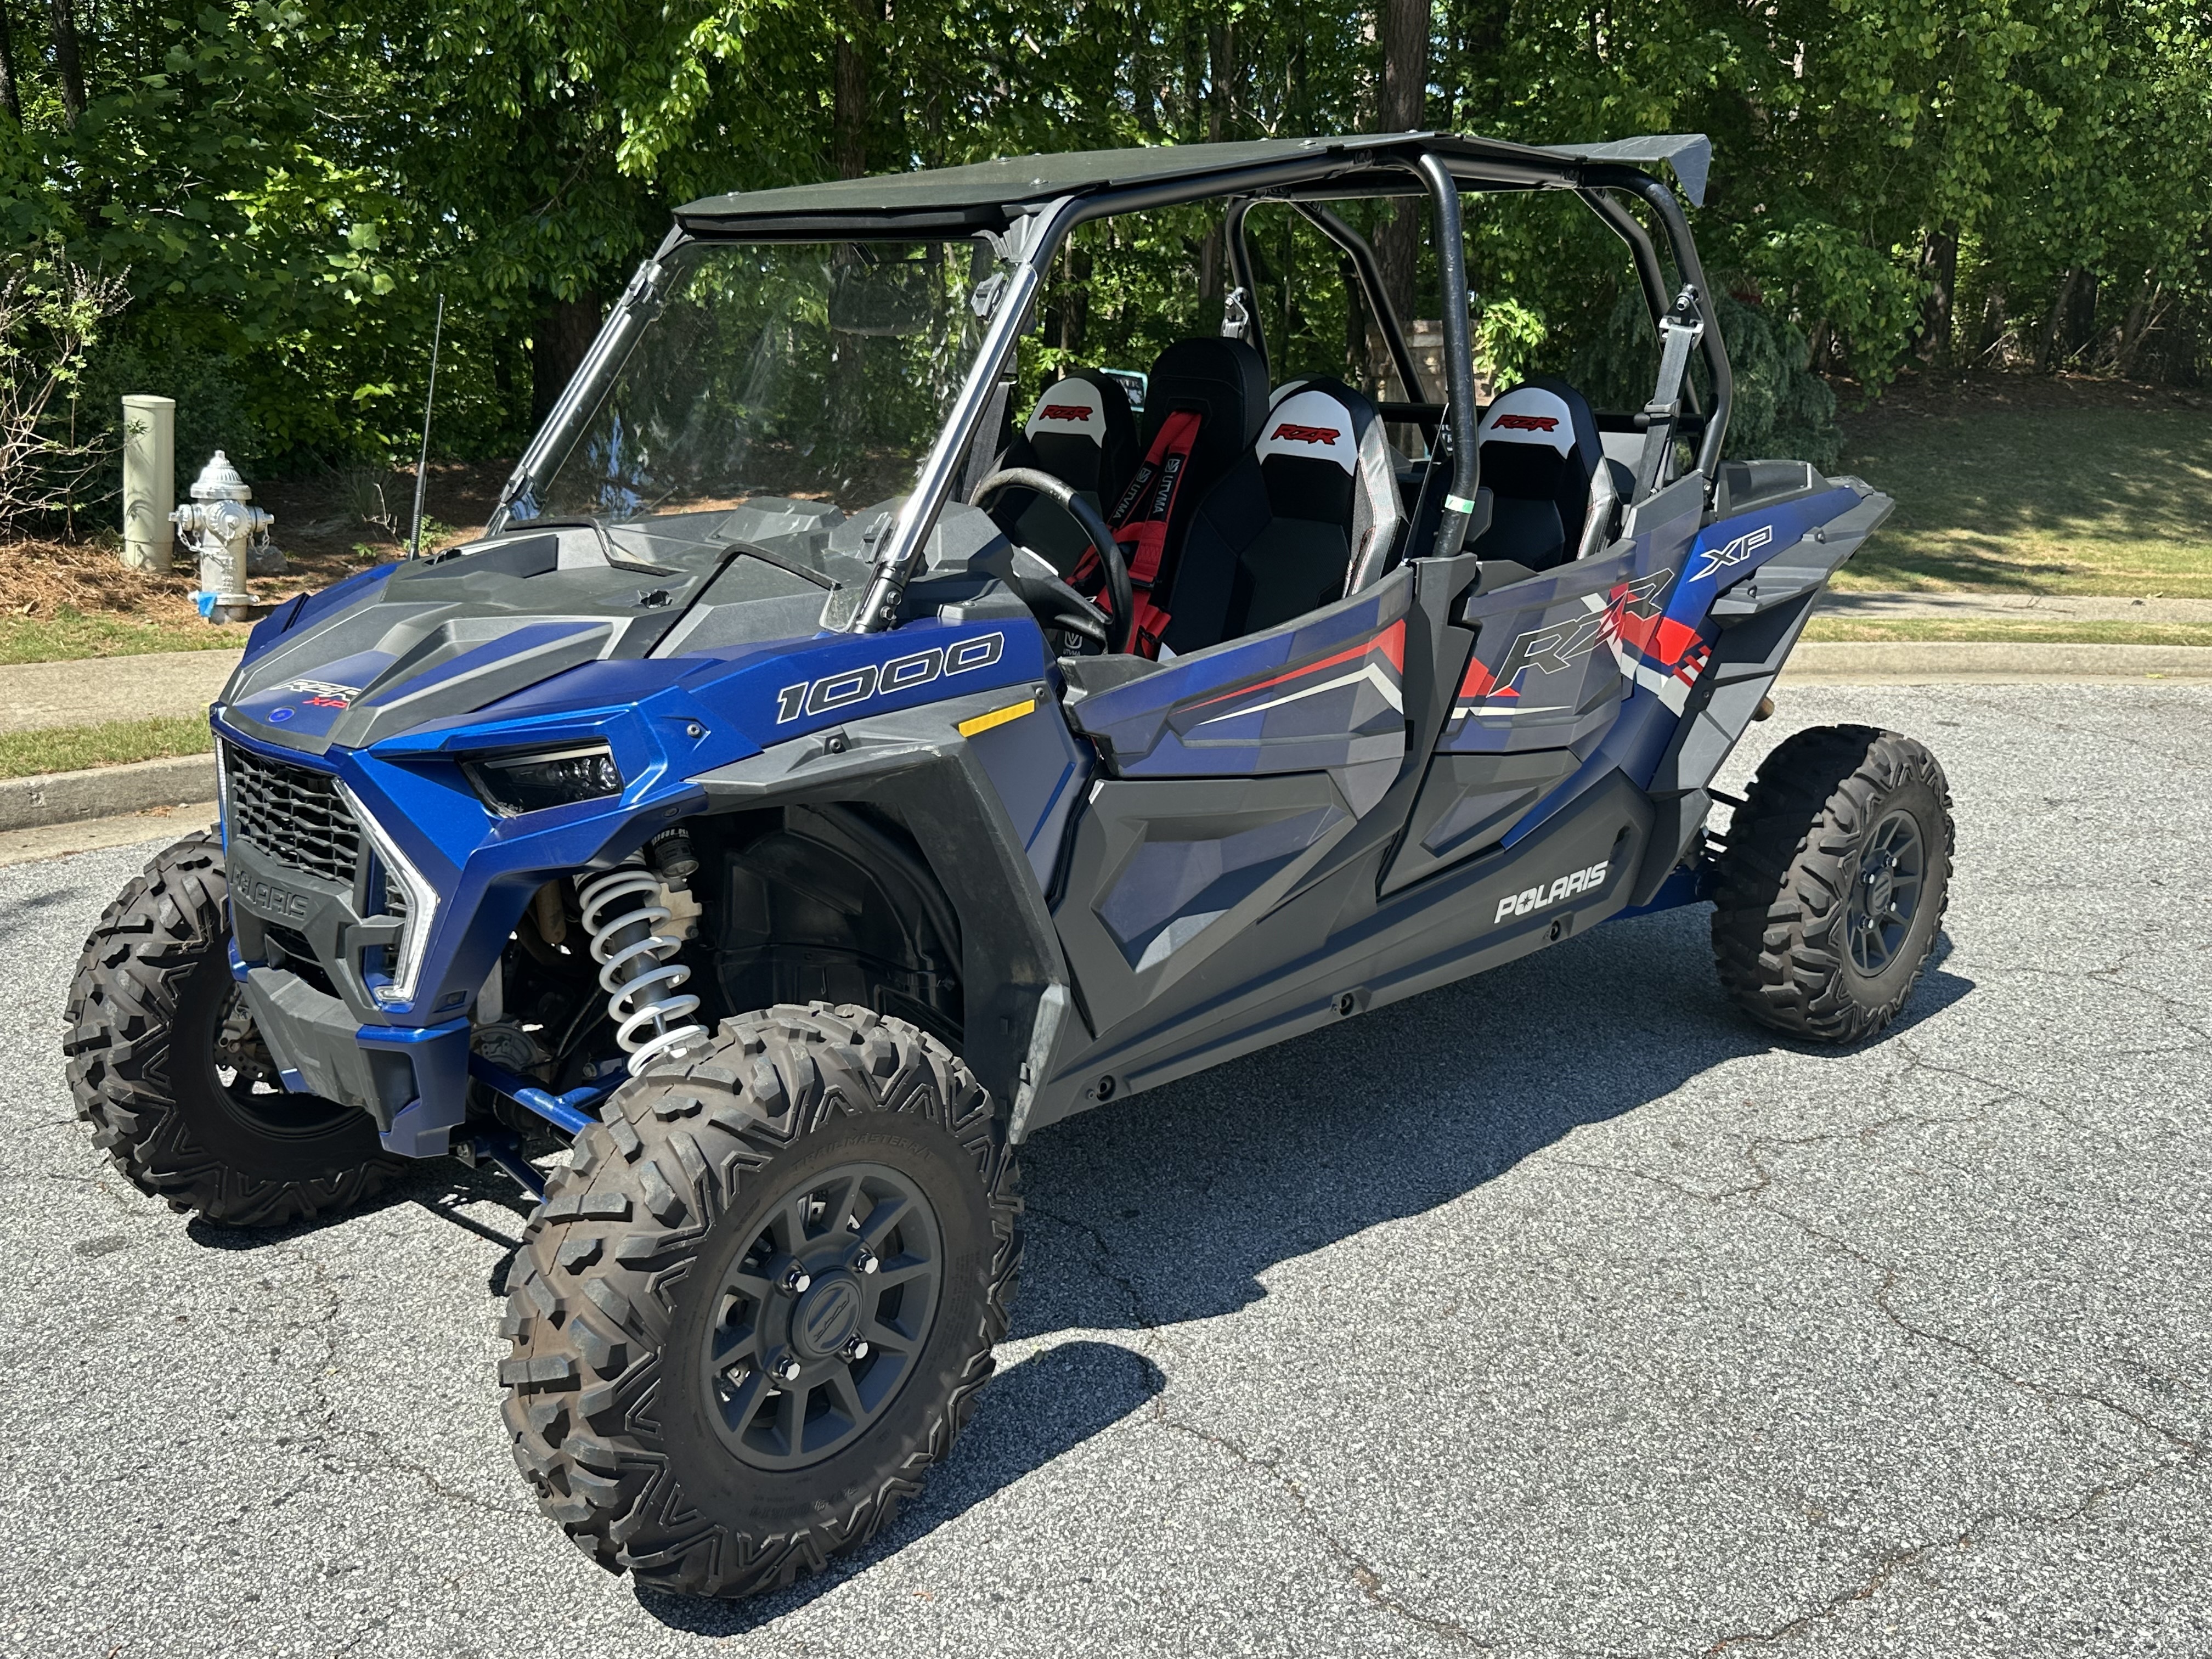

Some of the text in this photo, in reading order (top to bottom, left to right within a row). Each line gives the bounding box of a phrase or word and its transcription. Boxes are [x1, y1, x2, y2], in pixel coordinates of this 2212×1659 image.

[1039, 404, 1093, 422] RZR
[1491, 414, 1559, 432] RZR
[1270, 424, 1341, 445] RZR
[1112, 483, 1141, 518] UTVMA
[1153, 475, 1174, 514] UTVMA
[1686, 524, 1773, 584] XP
[1486, 567, 1674, 698] RZR
[268, 679, 362, 702] RZR
[776, 631, 1005, 724] 1000
[302, 697, 347, 708] XP
[230, 862, 309, 921] POLARIS
[1494, 860, 1609, 924] POLARIS
